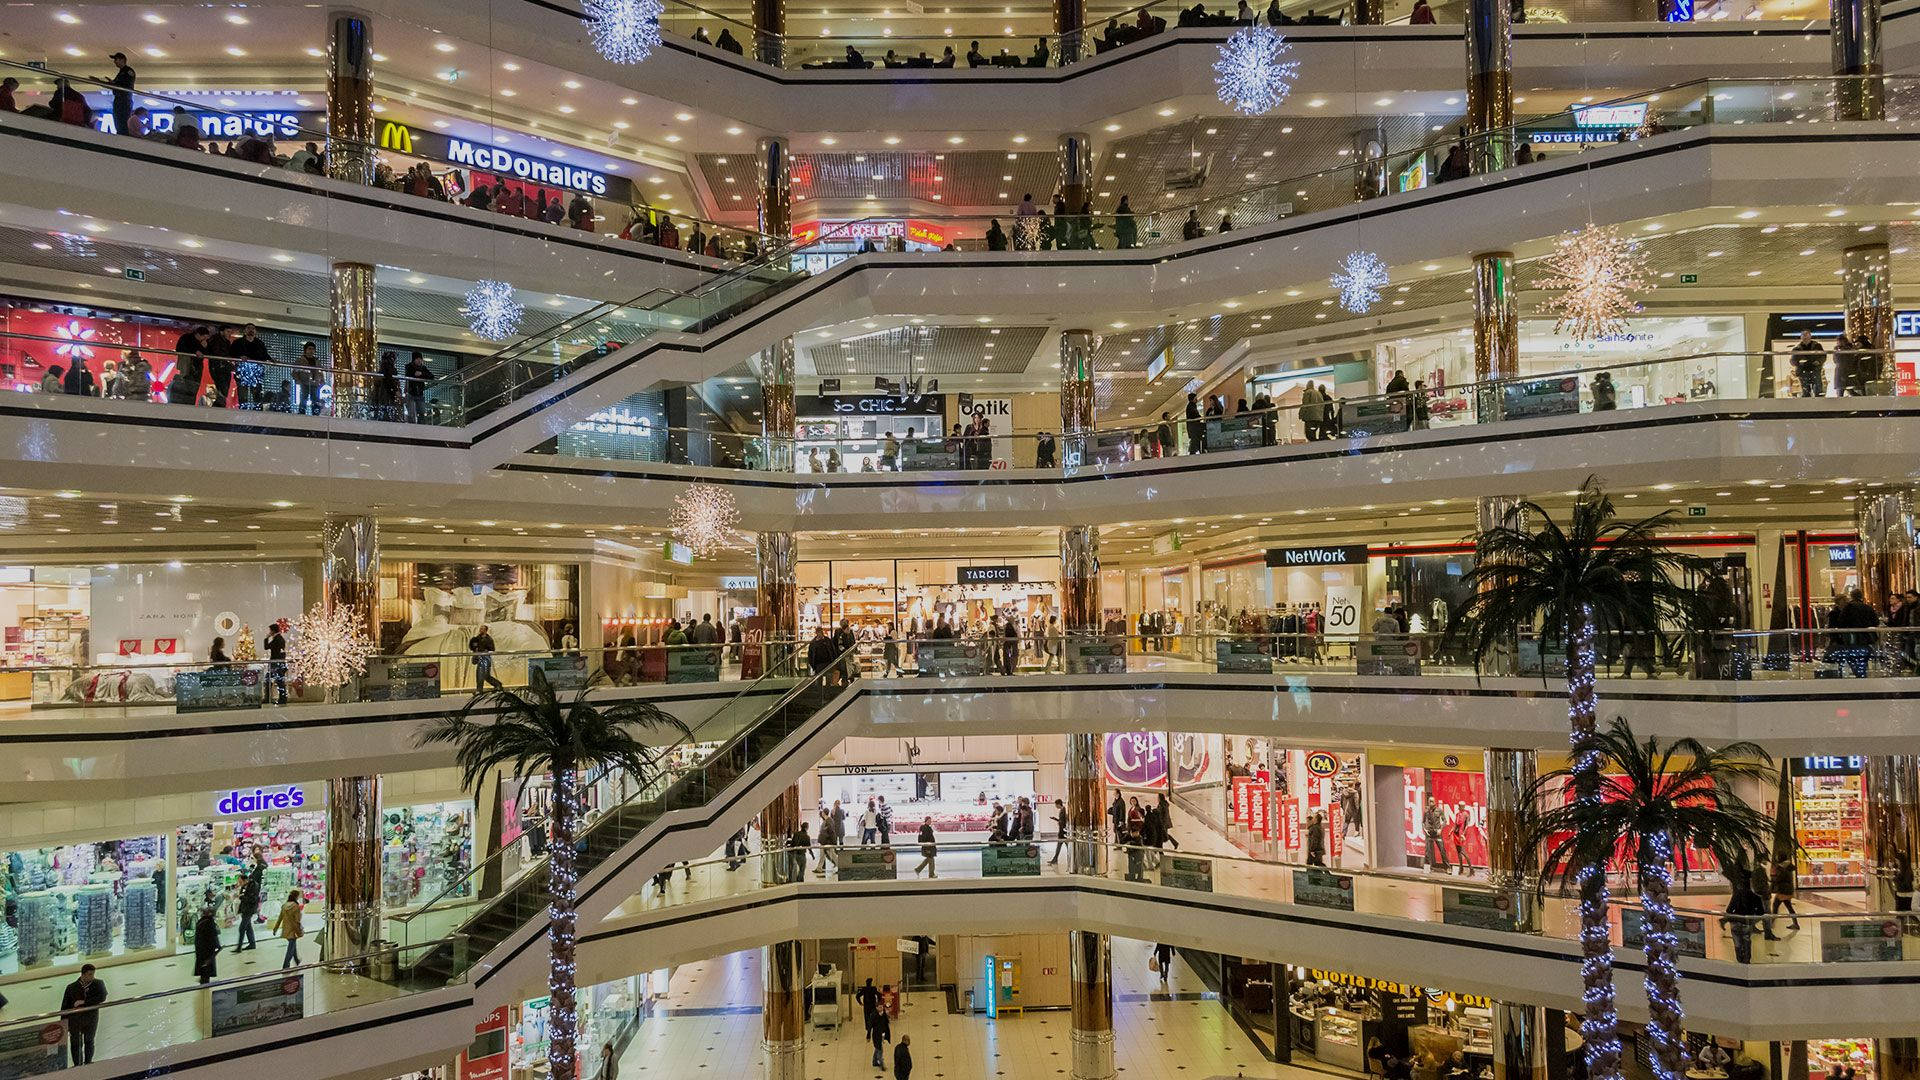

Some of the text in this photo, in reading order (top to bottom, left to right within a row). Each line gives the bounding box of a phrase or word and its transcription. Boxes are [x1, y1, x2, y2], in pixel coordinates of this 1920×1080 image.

[99, 112, 299, 137] MDnald's
[447, 139, 607, 195] McDonald's
[1285, 549, 1347, 563] NetWork
[966, 569, 1010, 579] YARGICI
[1329, 605, 1356, 626] 50
[219, 786, 304, 814] claire's
[480, 1012, 501, 1024] UPS
